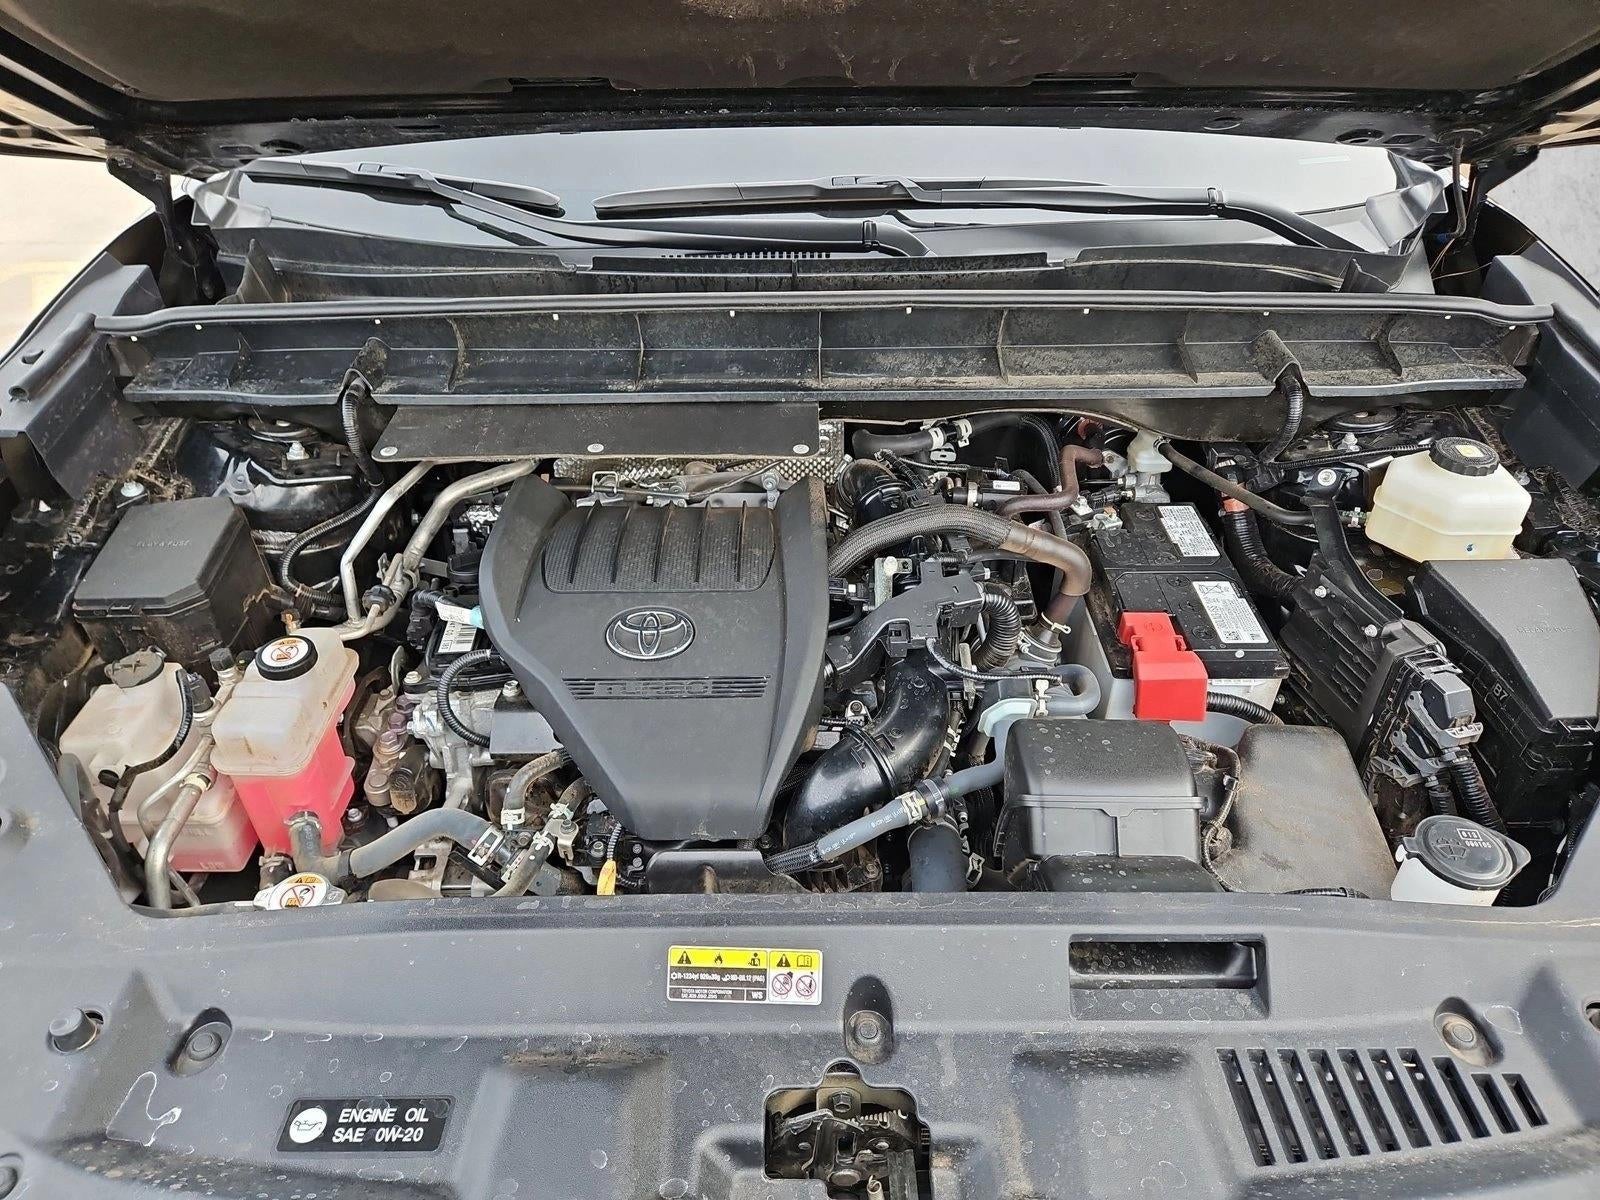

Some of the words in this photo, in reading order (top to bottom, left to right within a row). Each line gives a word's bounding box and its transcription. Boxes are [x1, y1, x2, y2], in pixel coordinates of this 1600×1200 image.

[597, 681, 710, 696] TURBO
[1493, 683, 1509, 701] B7
[751, 991, 764, 1000] WS
[338, 1108, 397, 1123] ENGINE
[405, 1107, 430, 1123] OIL
[332, 1127, 366, 1143] SAE
[375, 1127, 424, 1143] 0W-20
